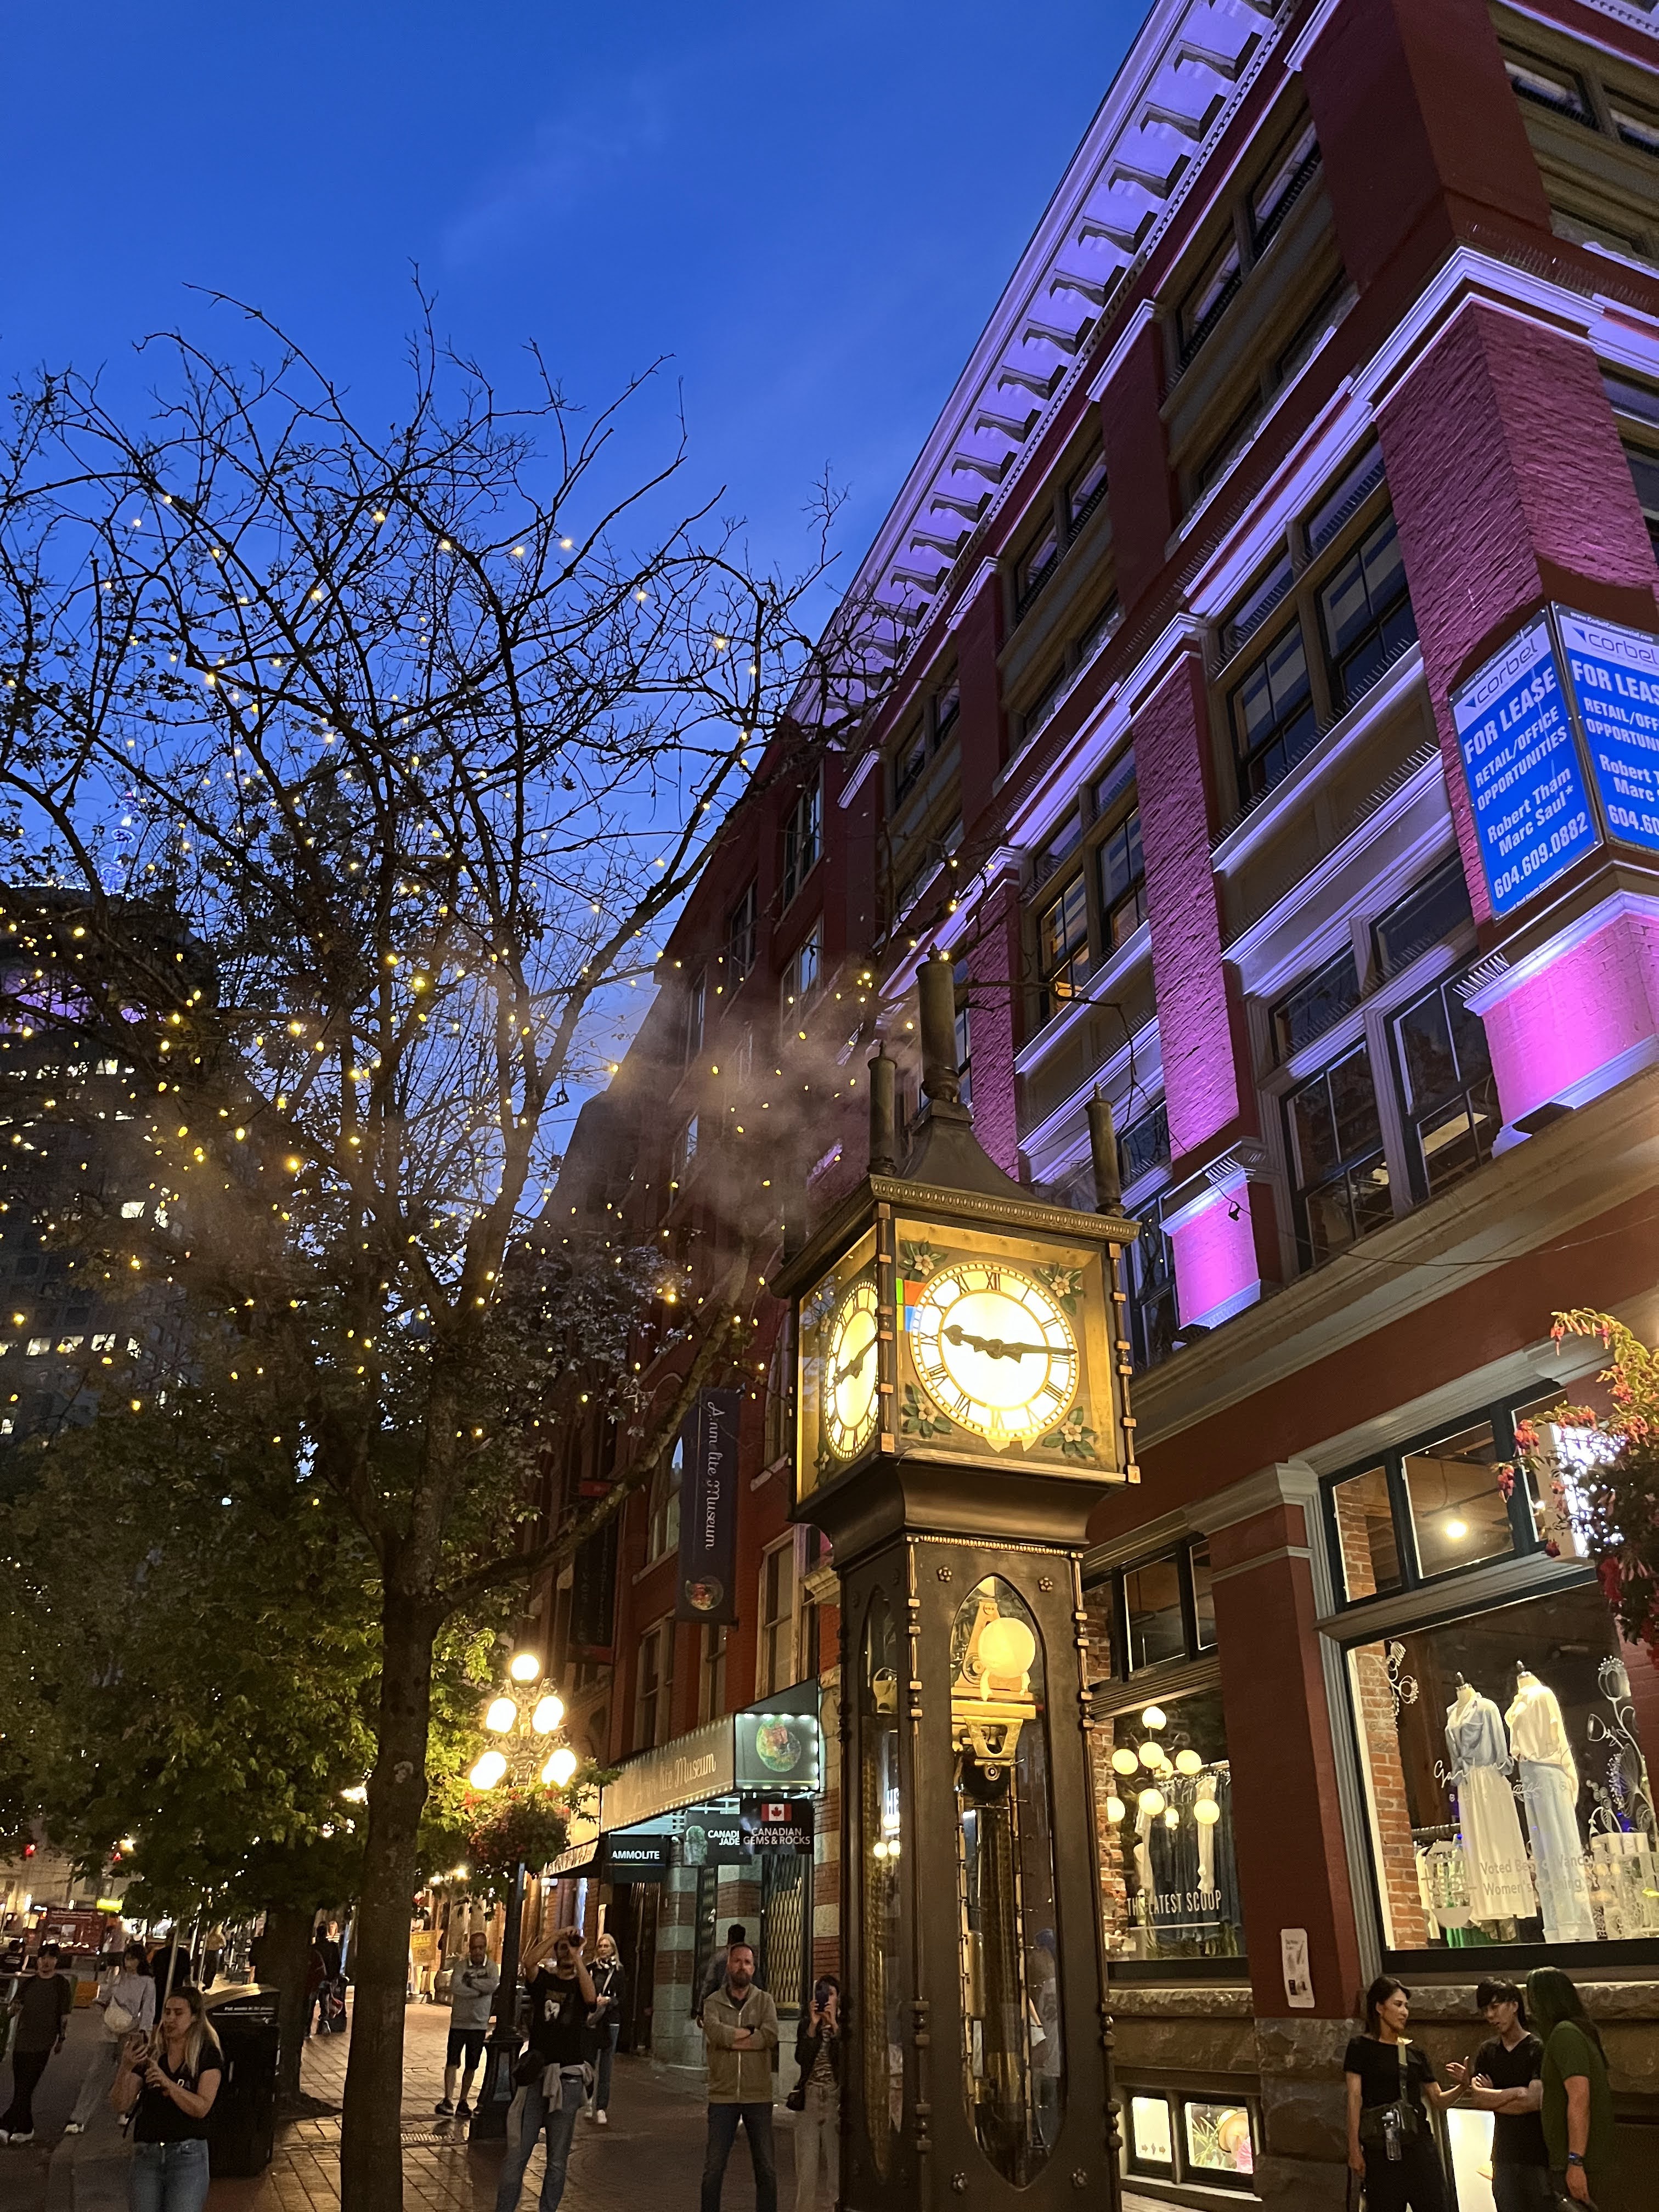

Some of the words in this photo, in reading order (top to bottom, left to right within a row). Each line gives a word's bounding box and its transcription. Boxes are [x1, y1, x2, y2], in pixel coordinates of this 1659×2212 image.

[1589, 633, 1658, 665] corbel
[1477, 637, 1538, 703] corbel
[1571, 659, 1612, 691] FOR
[1464, 720, 1499, 765] FOR
[1499, 666, 1556, 732] LEASE
[1475, 706, 1559, 789] RETAIL/OFFICE
[1477, 725, 1567, 811] OPPORTUNITIES
[1599, 754, 1652, 783] Robert
[1613, 777, 1655, 802] Marc
[1487, 799, 1531, 844] Robert
[1532, 768, 1571, 805] Tham
[1494, 811, 1588, 899] 604.609.0882
[1498, 821, 1534, 857] Marc
[706, 1480, 720, 1550] Museum
[675, 1753, 716, 1788] Museum
[719, 1837, 740, 1846] JADE
[743, 1836, 770, 1845] GEMS
[771, 1836, 778, 1845] &
[779, 1836, 810, 1845] ROCKS
[751, 1827, 802, 1836] CANADIAN
[611, 1850, 660, 1859] AMMOLITE
[1480, 1859, 1512, 1875] Voted
[1148, 1893, 1182, 1915] LATEST
[1186, 1889, 1221, 1912] SCOOP
[1483, 1880, 1532, 1896] Women's
